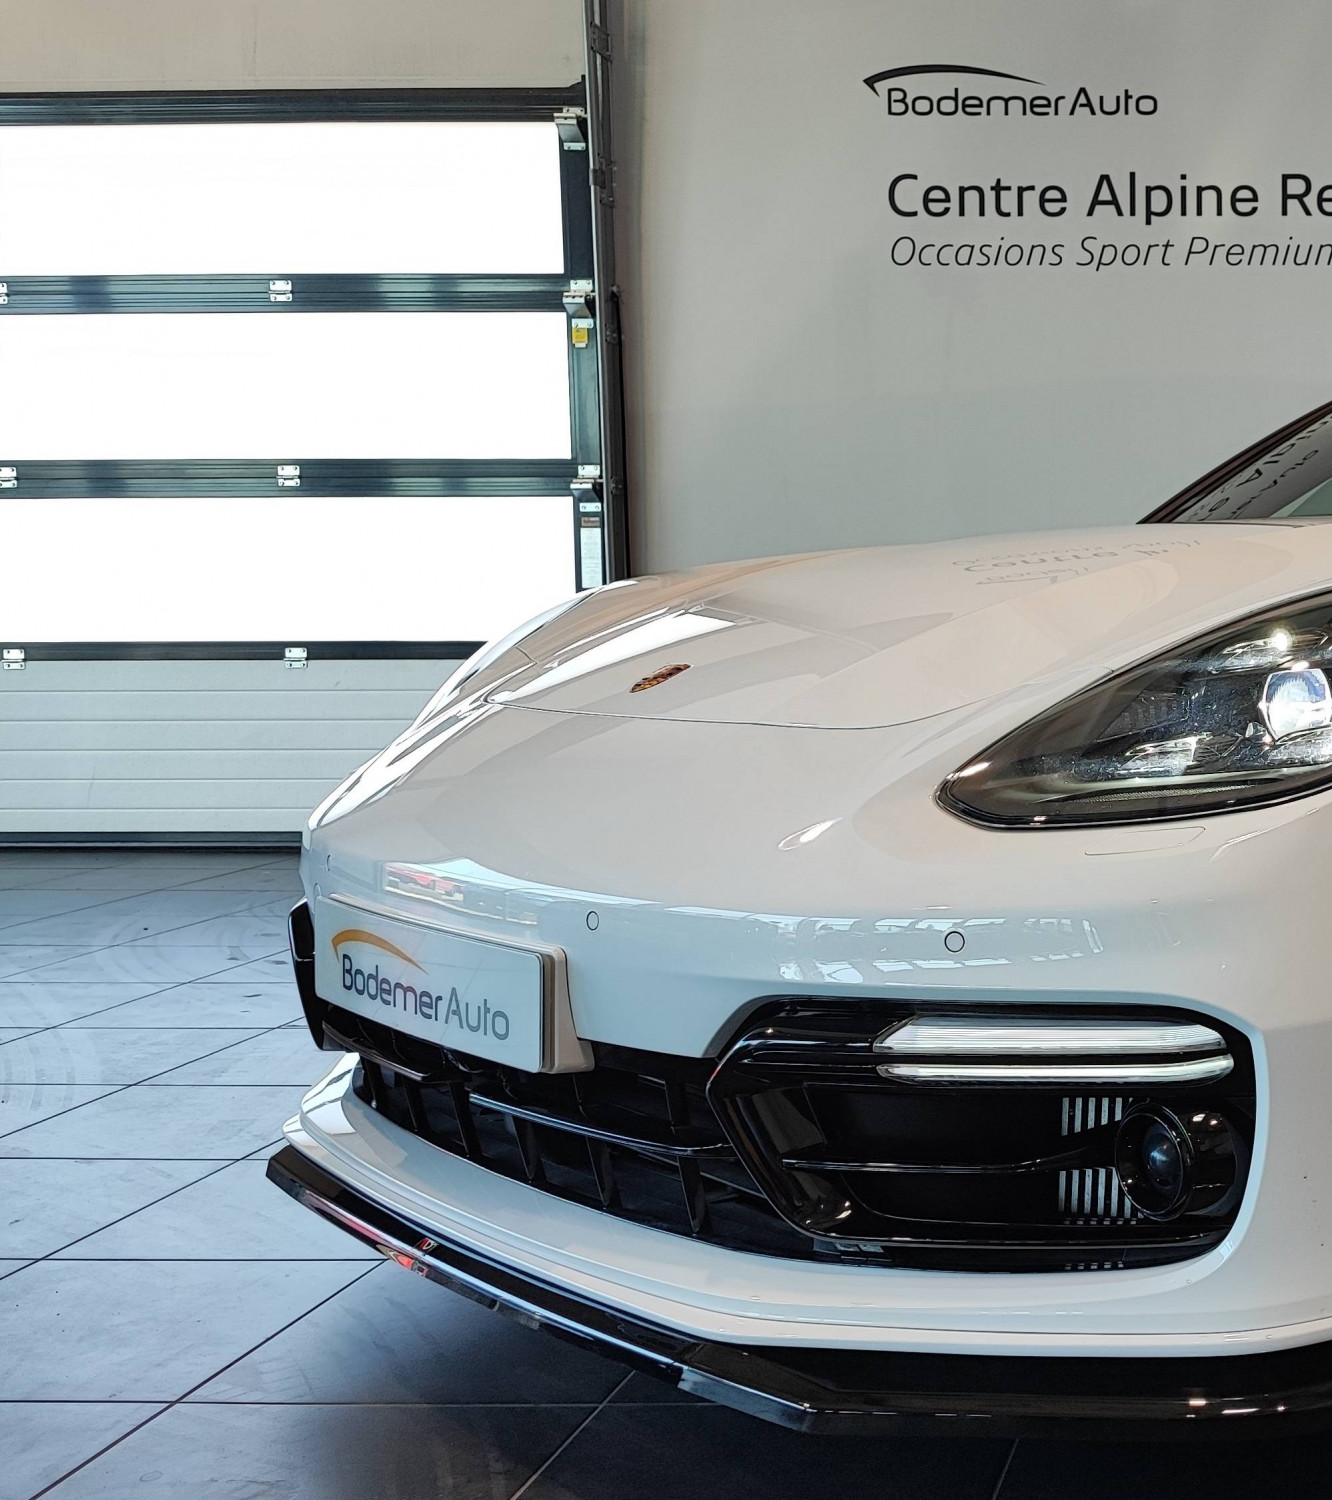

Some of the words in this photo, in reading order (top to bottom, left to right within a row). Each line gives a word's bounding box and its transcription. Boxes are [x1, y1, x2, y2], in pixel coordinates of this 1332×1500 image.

[887, 87, 1158, 116] BodemerAuto
[888, 174, 1068, 217] Centre
[1086, 171, 1260, 226] Alpine
[891, 236, 1065, 266] Occasions
[1075, 236, 1174, 271] Sport
[342, 953, 509, 1041] BodemerAuto
